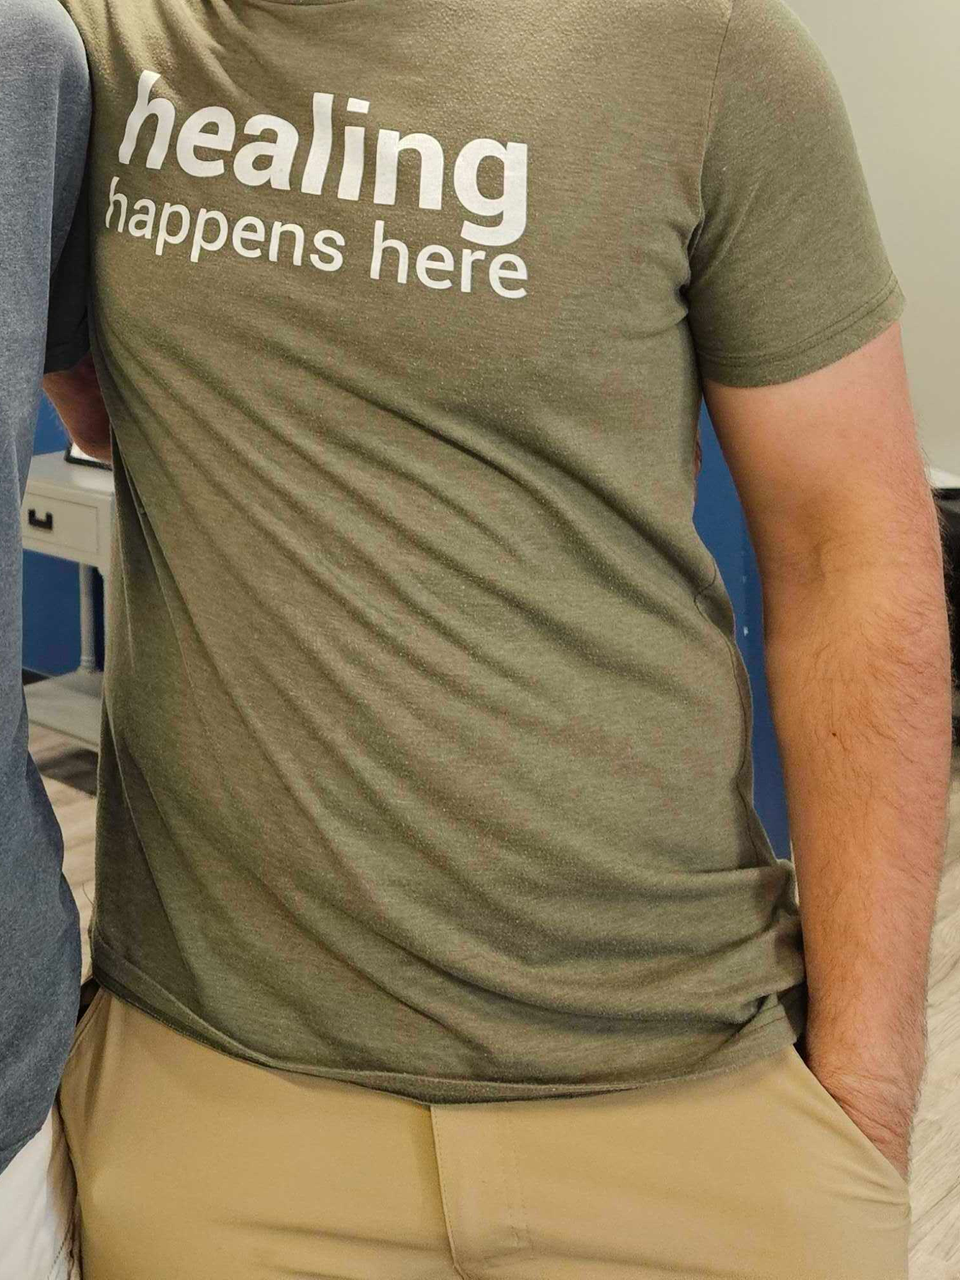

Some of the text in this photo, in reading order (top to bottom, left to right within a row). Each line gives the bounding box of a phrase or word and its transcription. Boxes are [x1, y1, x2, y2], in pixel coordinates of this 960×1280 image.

[118, 70, 528, 246] healing
[105, 176, 528, 299] happens here
